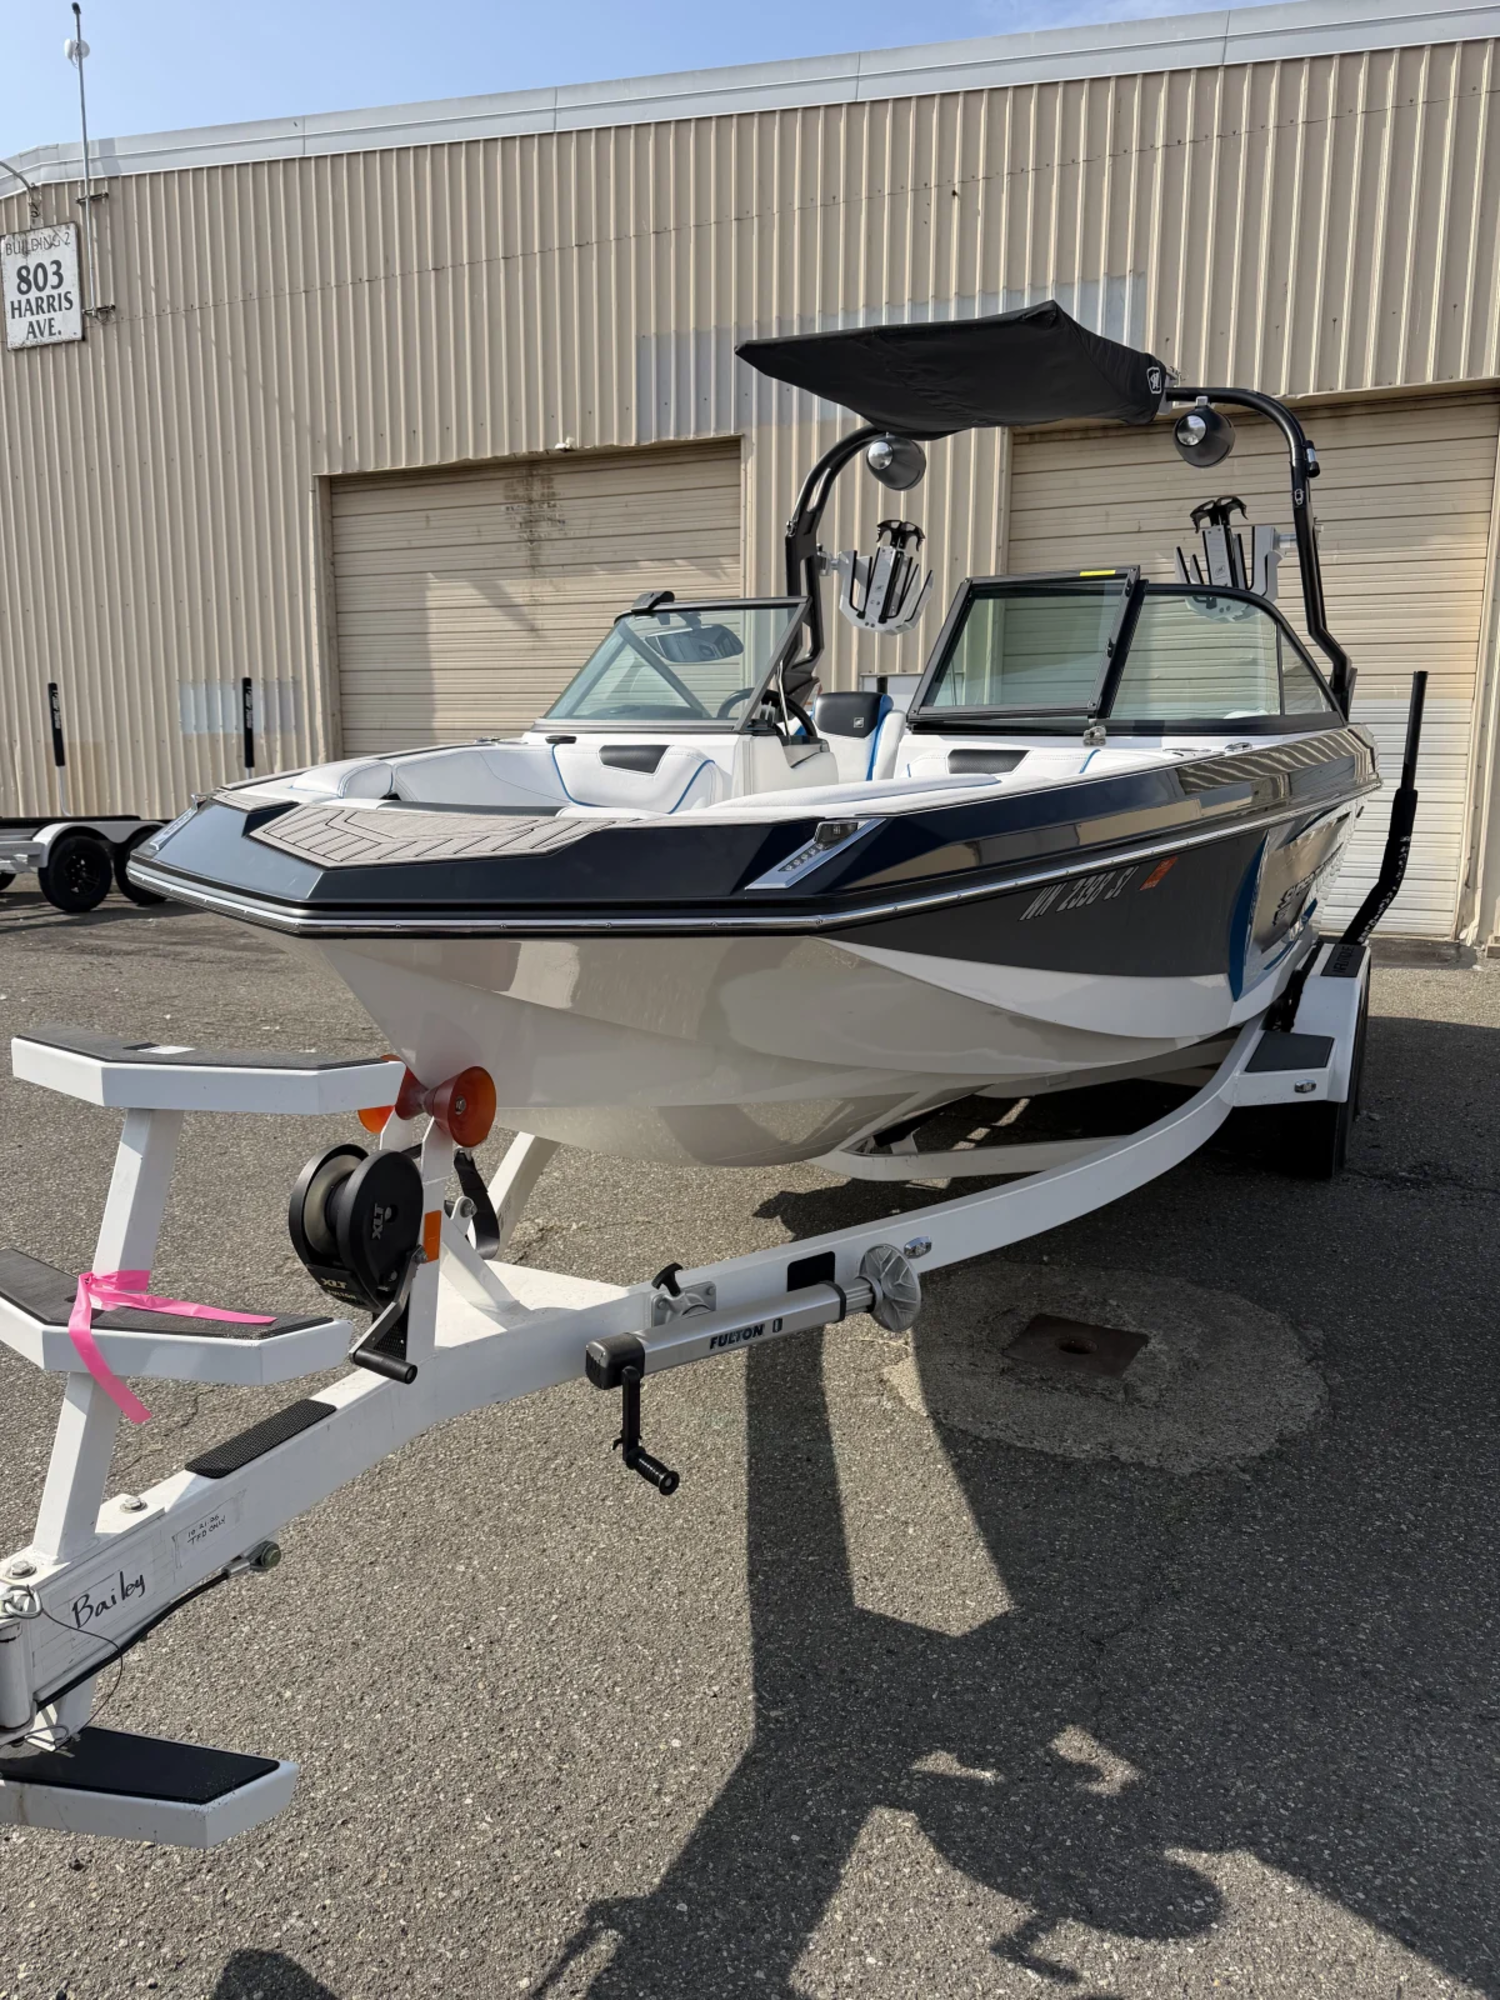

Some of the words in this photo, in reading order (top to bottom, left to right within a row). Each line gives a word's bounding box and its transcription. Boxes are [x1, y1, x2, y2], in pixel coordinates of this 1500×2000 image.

[5, 234, 61, 256] BUILDING
[64, 231, 71, 245] 2
[16, 259, 64, 296] 803
[10, 291, 74, 319] HARRIS
[26, 317, 62, 340] AVE.
[1019, 882, 1068, 921] WN
[1056, 871, 1117, 912] 2398
[371, 1203, 384, 1240] XLT
[320, 1277, 347, 1289] XLT
[709, 1323, 765, 1349] FULTON
[71, 1570, 146, 1629] Bailey
